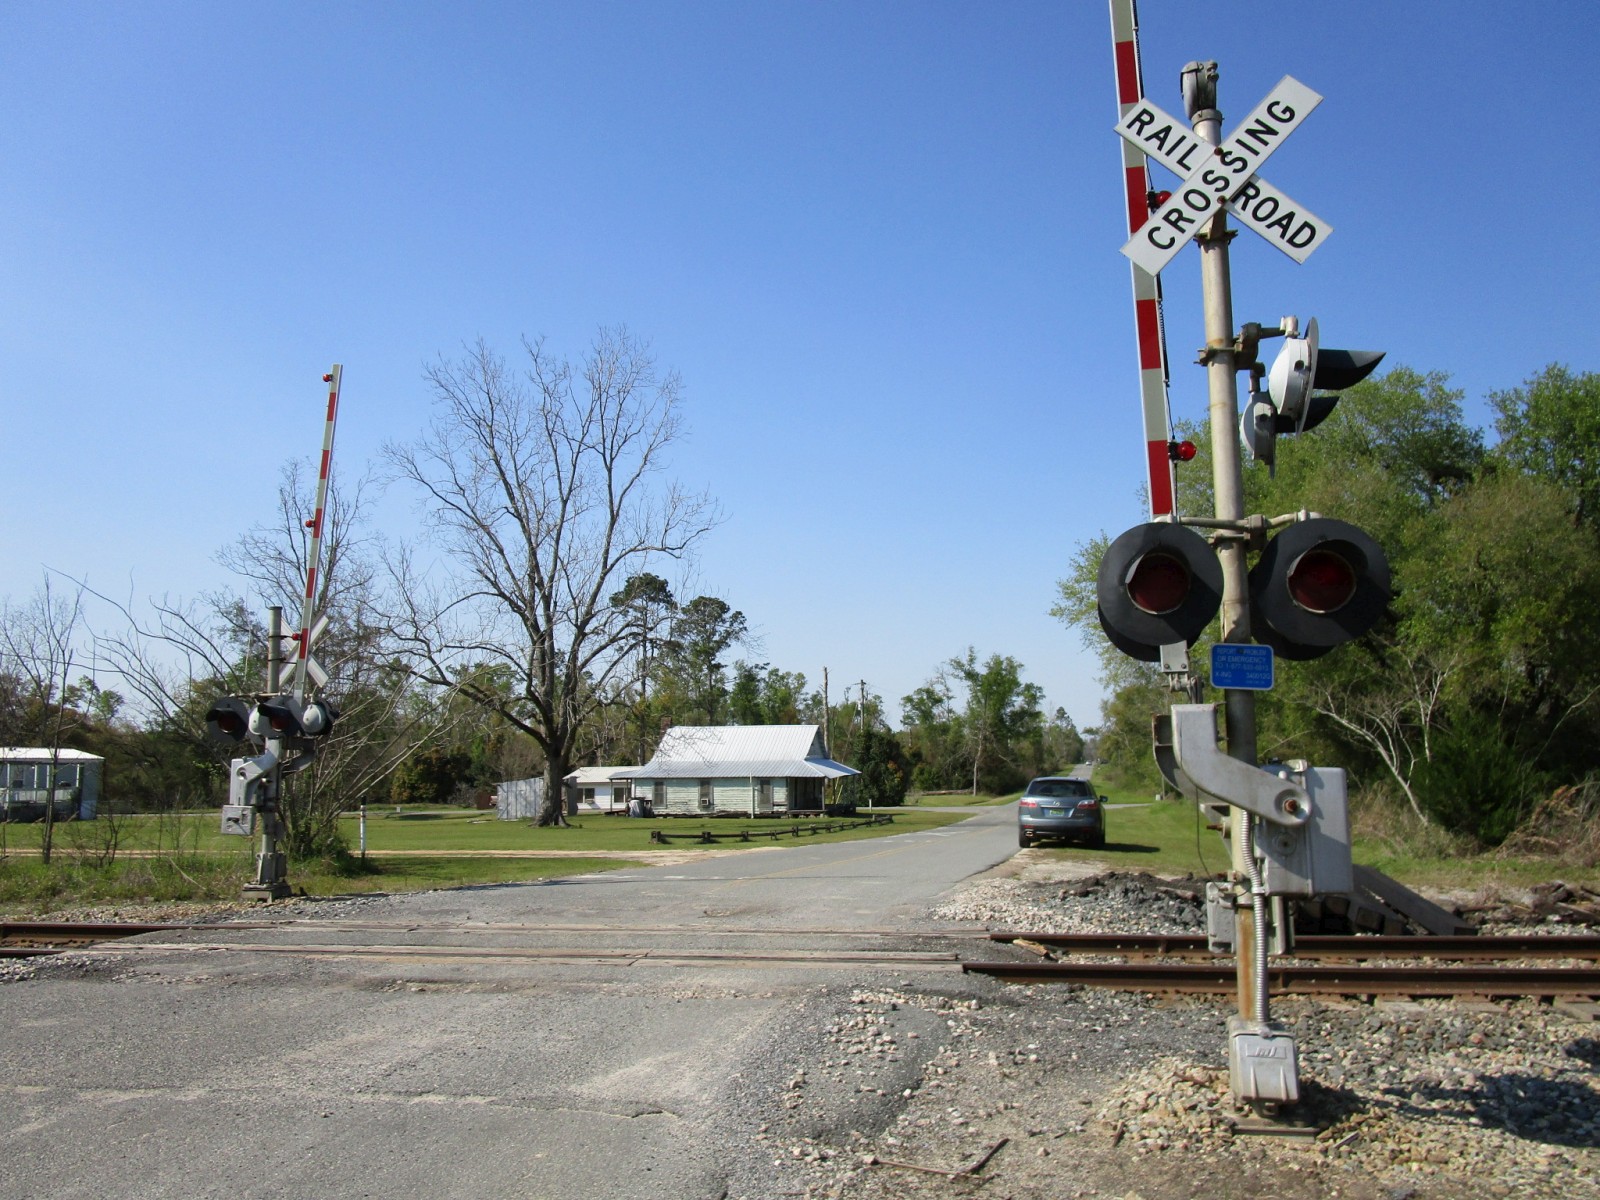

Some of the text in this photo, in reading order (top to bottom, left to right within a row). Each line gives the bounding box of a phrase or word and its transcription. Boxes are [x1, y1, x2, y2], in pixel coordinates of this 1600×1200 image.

[1126, 108, 1316, 249] RAIL ROAD
[1147, 101, 1296, 250] CROSSING
